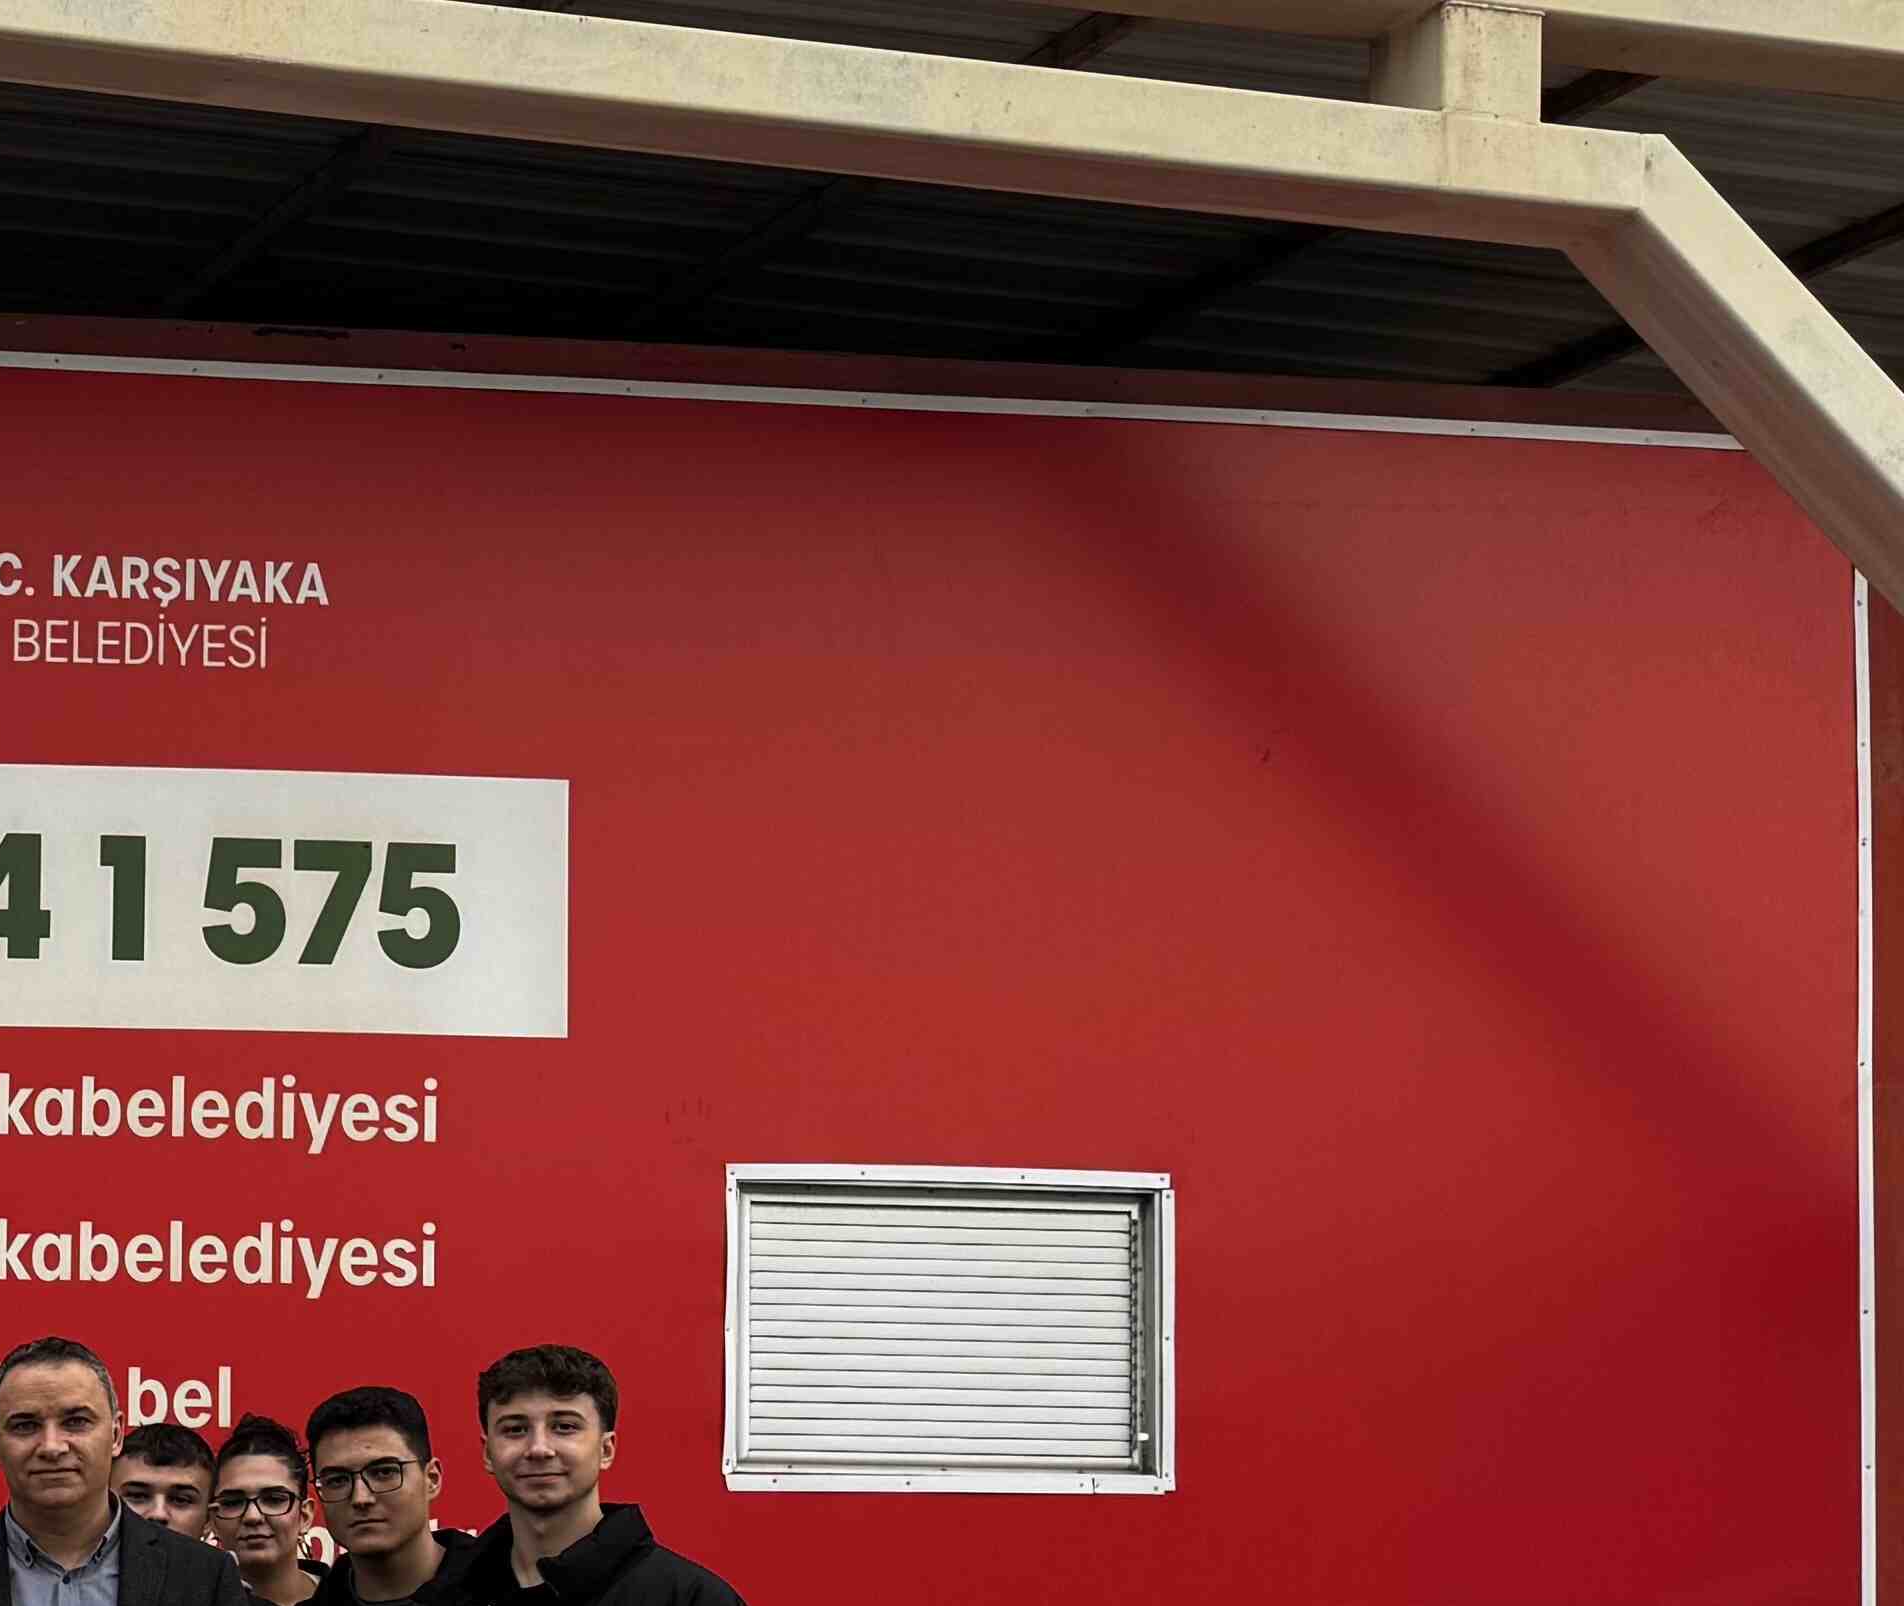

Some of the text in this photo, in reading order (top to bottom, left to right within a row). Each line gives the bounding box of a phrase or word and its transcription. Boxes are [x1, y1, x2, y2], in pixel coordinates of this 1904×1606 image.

[47, 554, 329, 608] KARŞIYAKA
[13, 614, 268, 668] BELEDİYESİ
[99, 834, 147, 961] 1
[202, 837, 461, 970] 575
